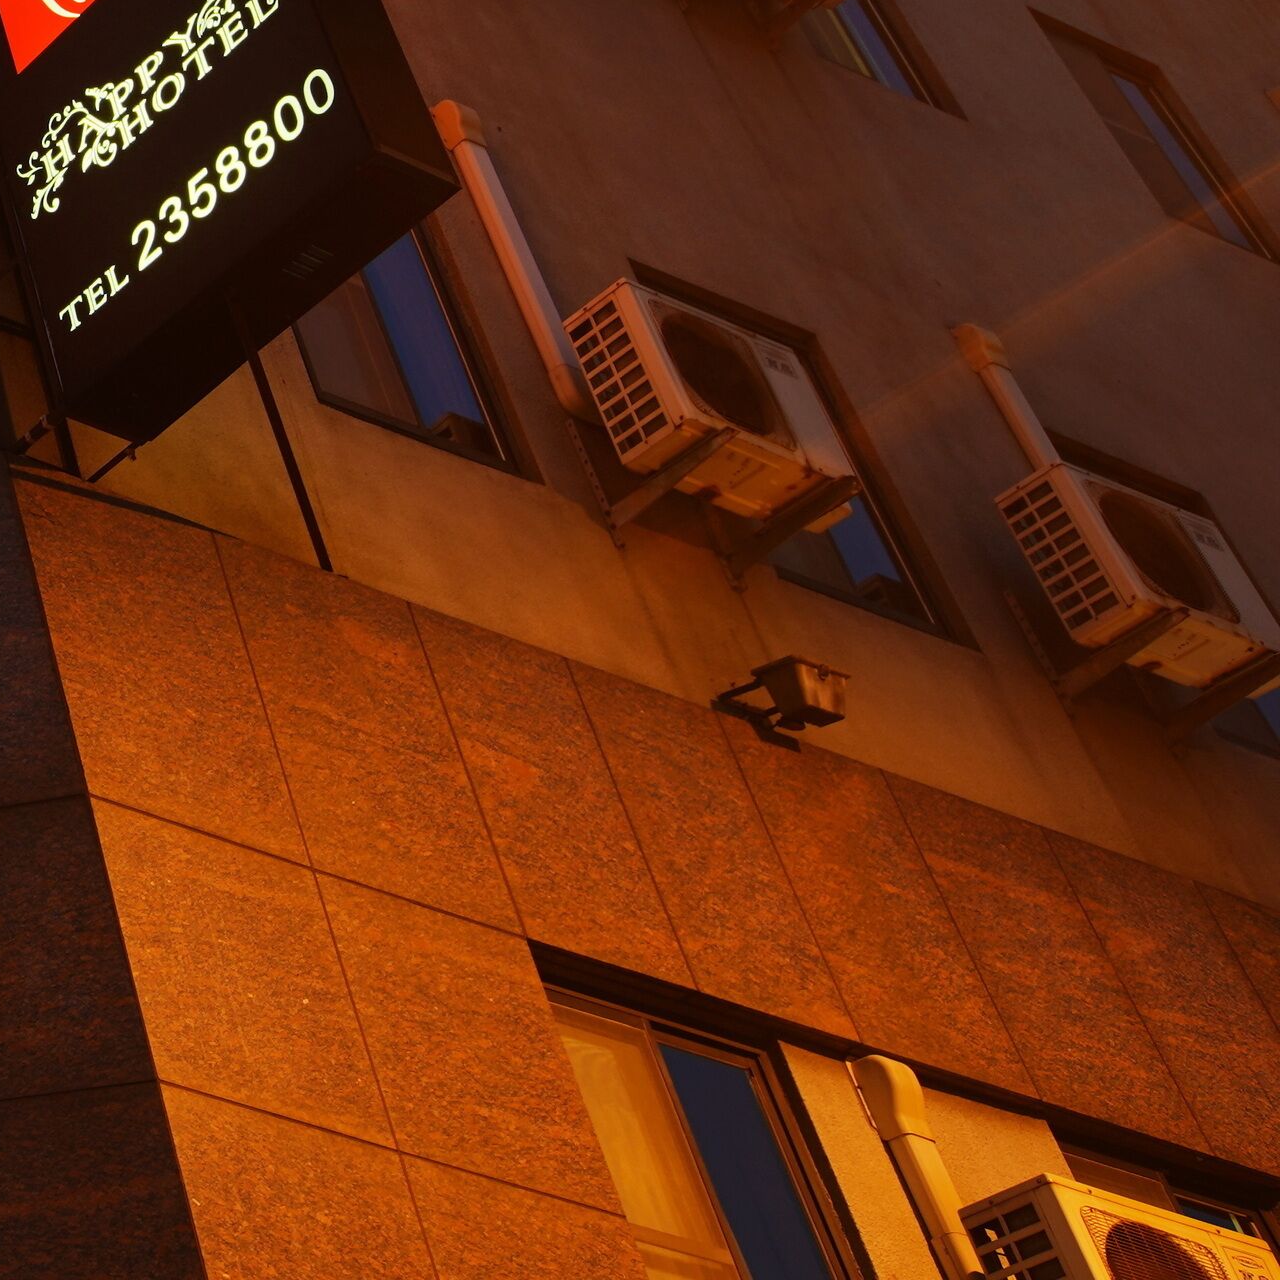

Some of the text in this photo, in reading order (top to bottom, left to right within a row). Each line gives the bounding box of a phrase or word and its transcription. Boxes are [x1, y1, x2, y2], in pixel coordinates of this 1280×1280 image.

[32, 10, 206, 186] HAPPY
[59, 69, 335, 332] TEL 2358800
